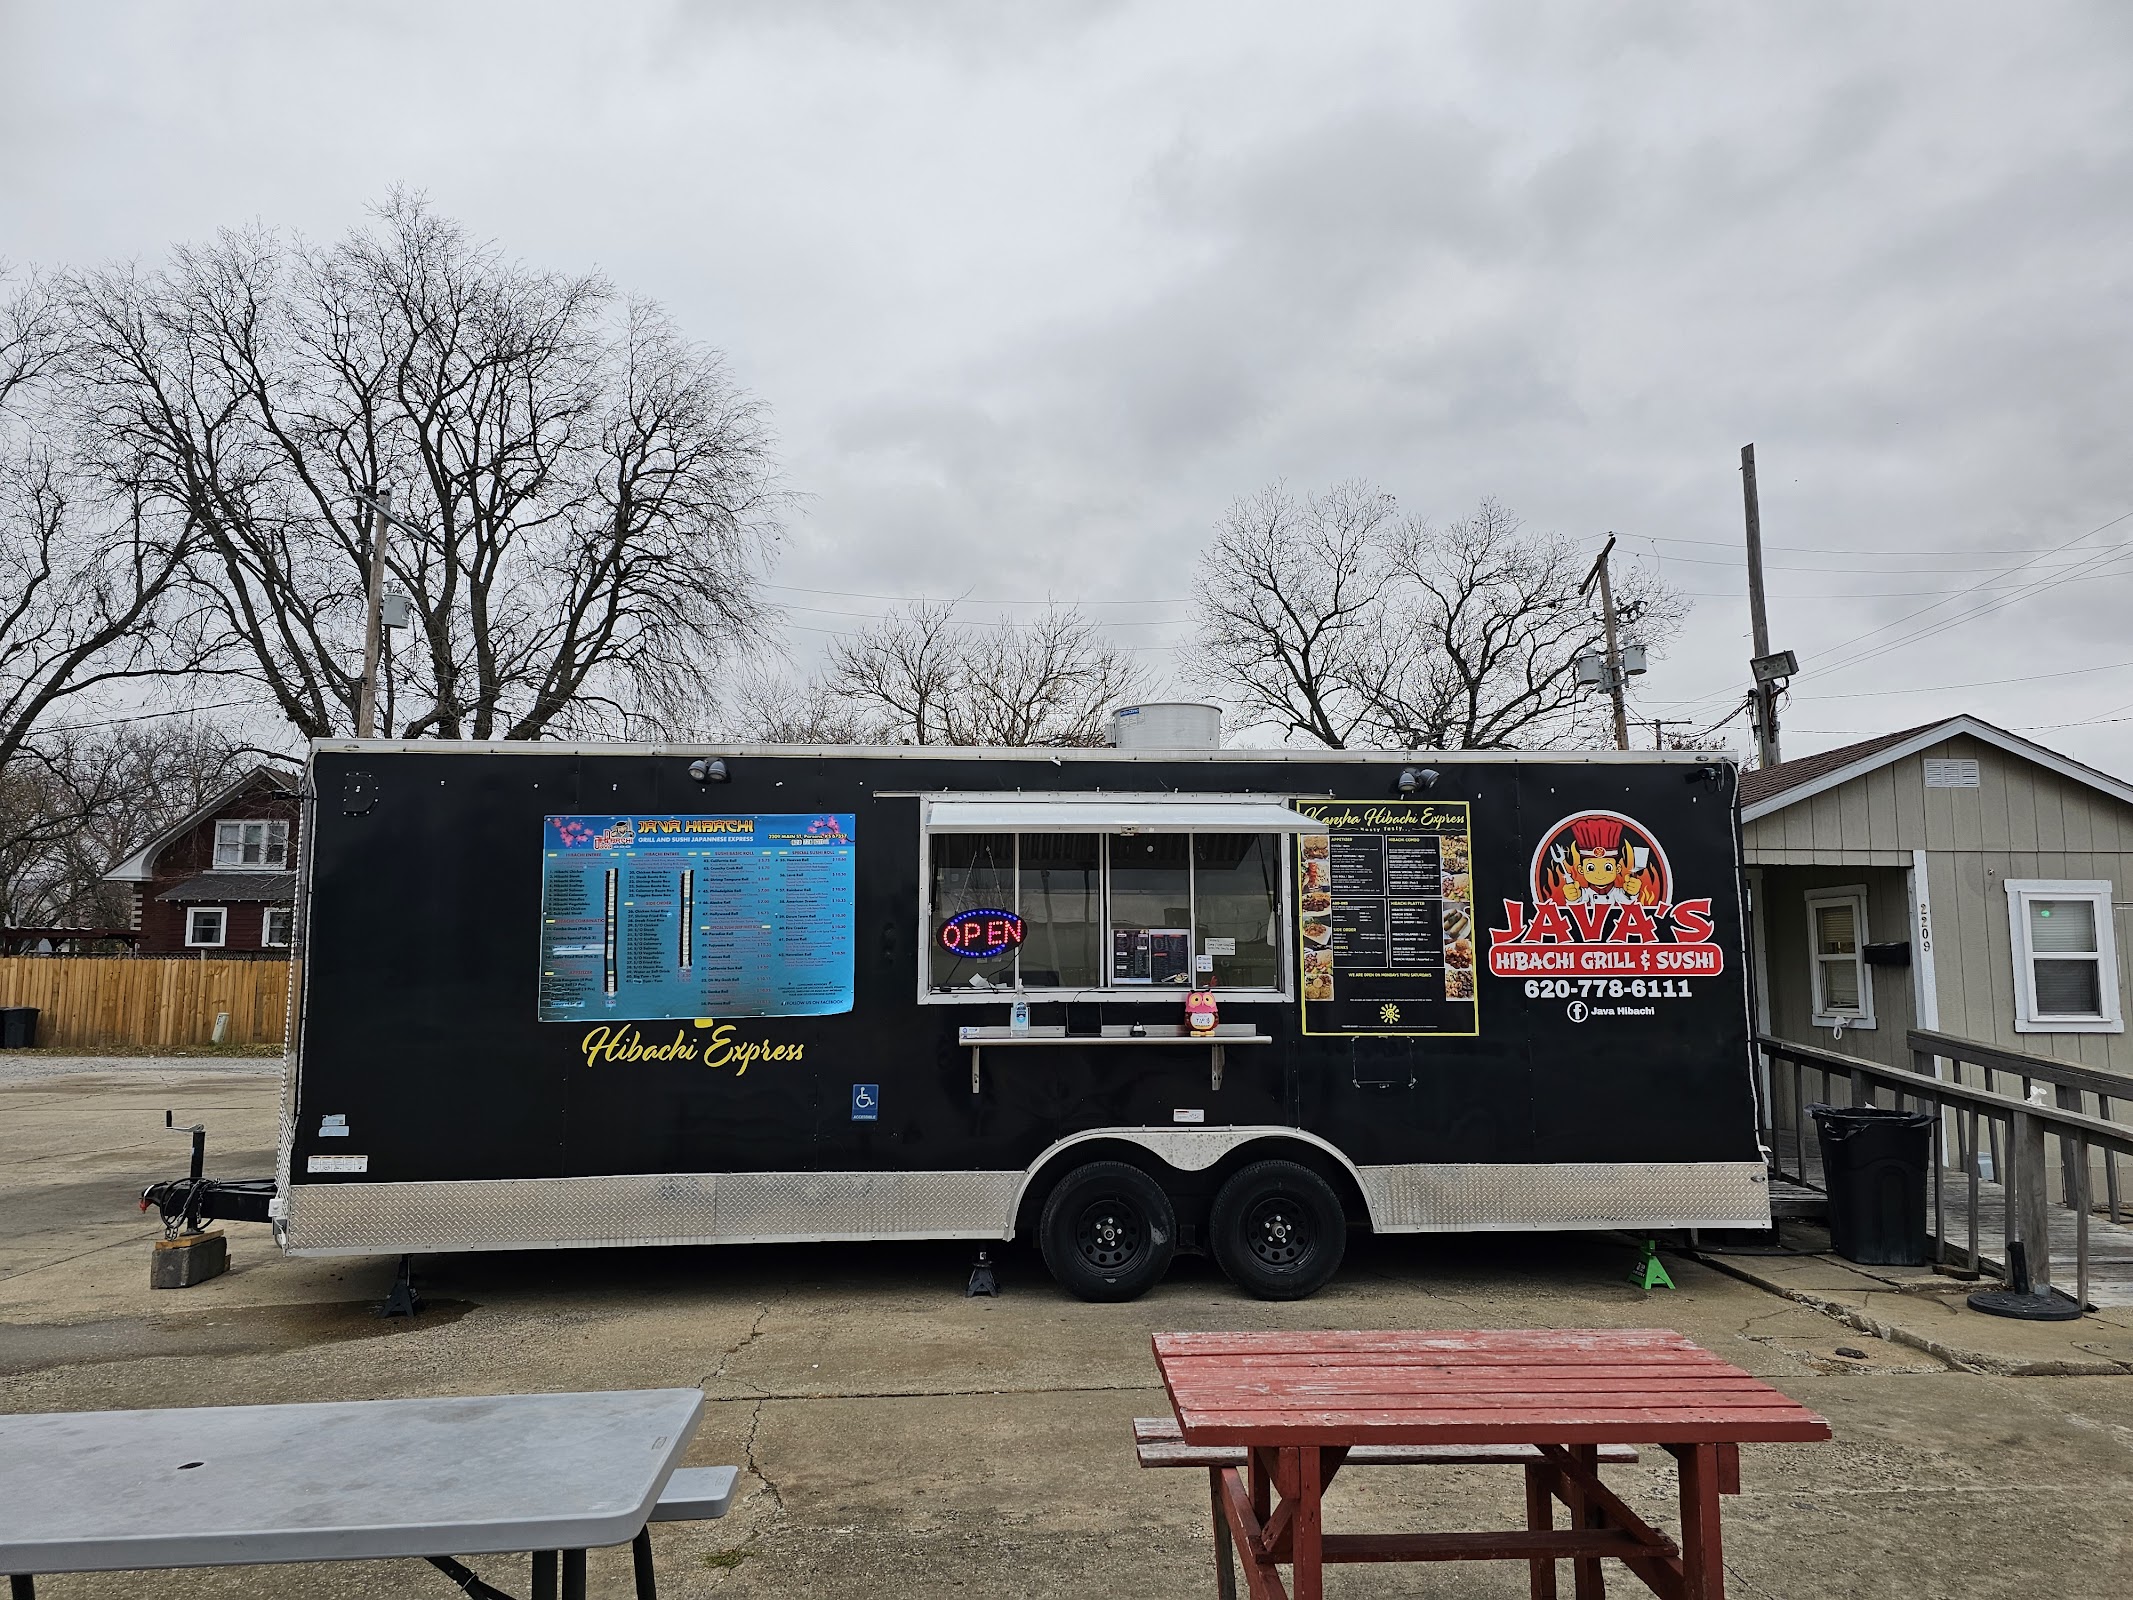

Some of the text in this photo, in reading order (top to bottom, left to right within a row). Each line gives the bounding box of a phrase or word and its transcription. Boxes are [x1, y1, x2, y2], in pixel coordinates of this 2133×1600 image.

[637, 819, 754, 833] JAVA HIBACHI
[1364, 806, 1418, 826] Hibachi
[1420, 807, 1465, 830] Express
[943, 920, 1022, 947] OPEN
[1489, 899, 1714, 944] JAVA'S
[1920, 903, 1930, 952] 2209
[1496, 950, 1714, 971] HIBACHI GRILL & SUSHI
[1524, 979, 1692, 998] 620-778-6111
[1590, 1006, 1655, 1015] Java Hibachi
[581, 1023, 804, 1076] Hibachi Express
